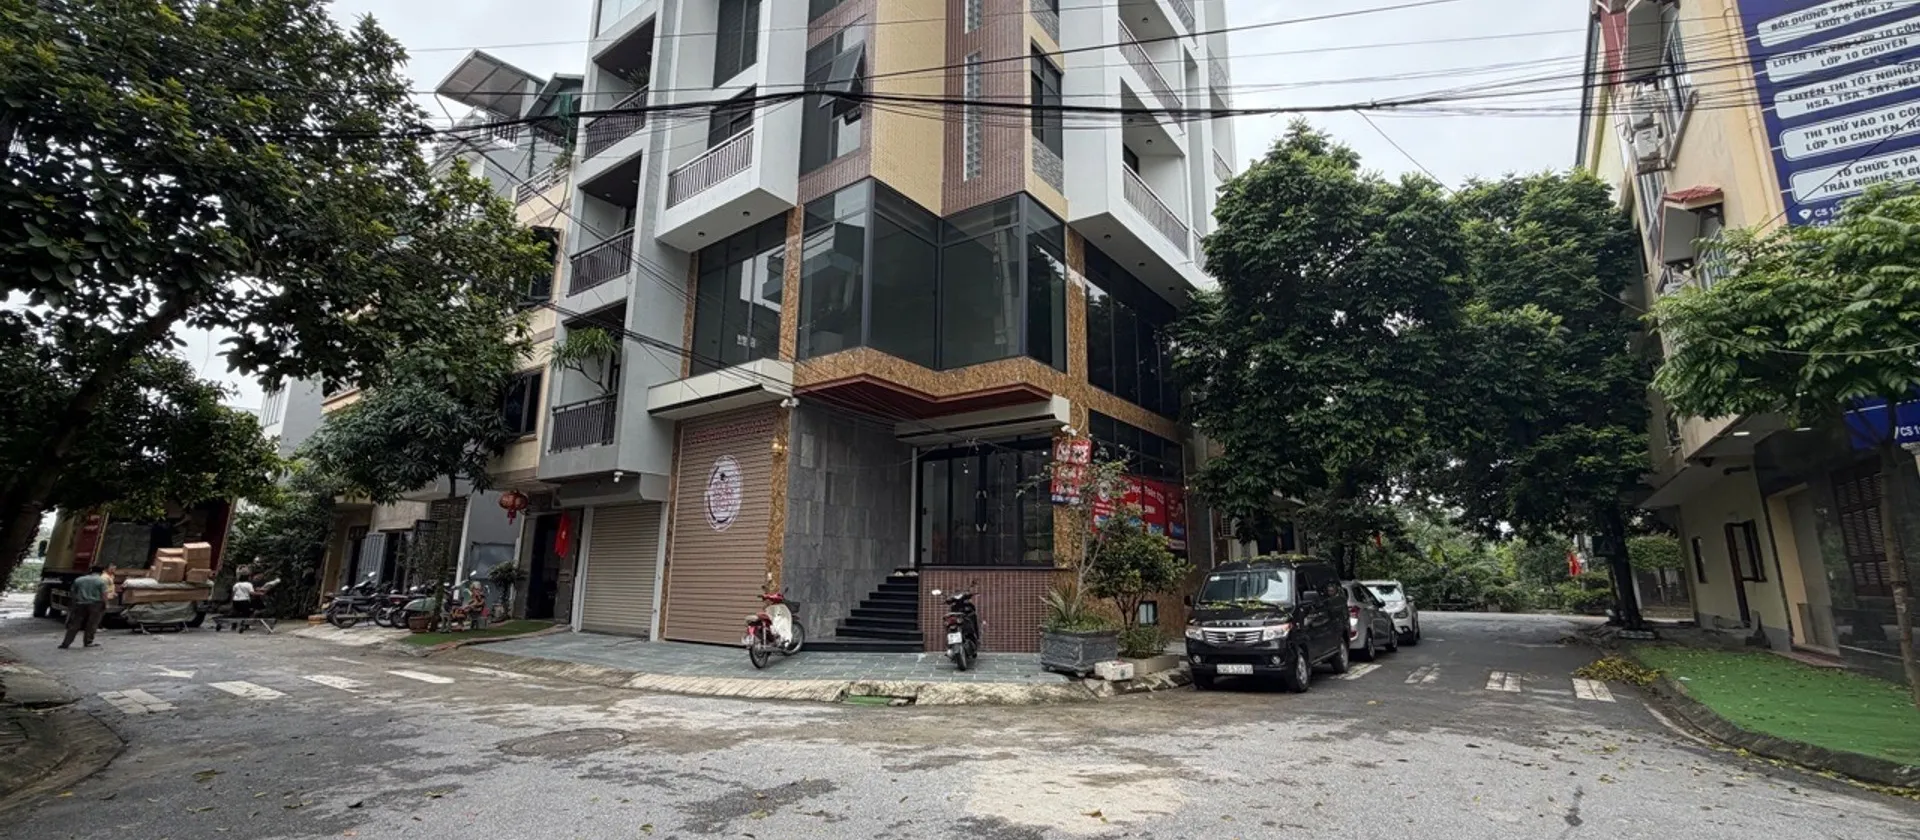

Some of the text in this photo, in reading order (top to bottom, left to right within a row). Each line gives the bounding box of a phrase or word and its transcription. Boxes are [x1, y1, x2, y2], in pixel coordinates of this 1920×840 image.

[1880, 1, 1894, 11] 12
[1879, 28, 1893, 39] 10
[1820, 36, 1908, 67] LỚP 10 CHUYÊN
[1828, 80, 1849, 93] THI
[1850, 73, 1873, 88] TỐT
[1806, 97, 1835, 110] HSA,
[1837, 90, 1865, 103] TSA,
[1803, 129, 1823, 140] THI
[1825, 120, 1850, 135] THỬ
[1851, 116, 1876, 130] VÀO
[1879, 112, 1896, 123] 10
[1805, 139, 1829, 152] LỚP
[1832, 135, 1848, 146] 10
[1855, 158, 1890, 175] CHỨC
[1892, 153, 1918, 167] TỌA
[1823, 178, 1851, 193] TRẢI
[1814, 207, 1829, 218] CS
[1900, 426, 1913, 437] CS
